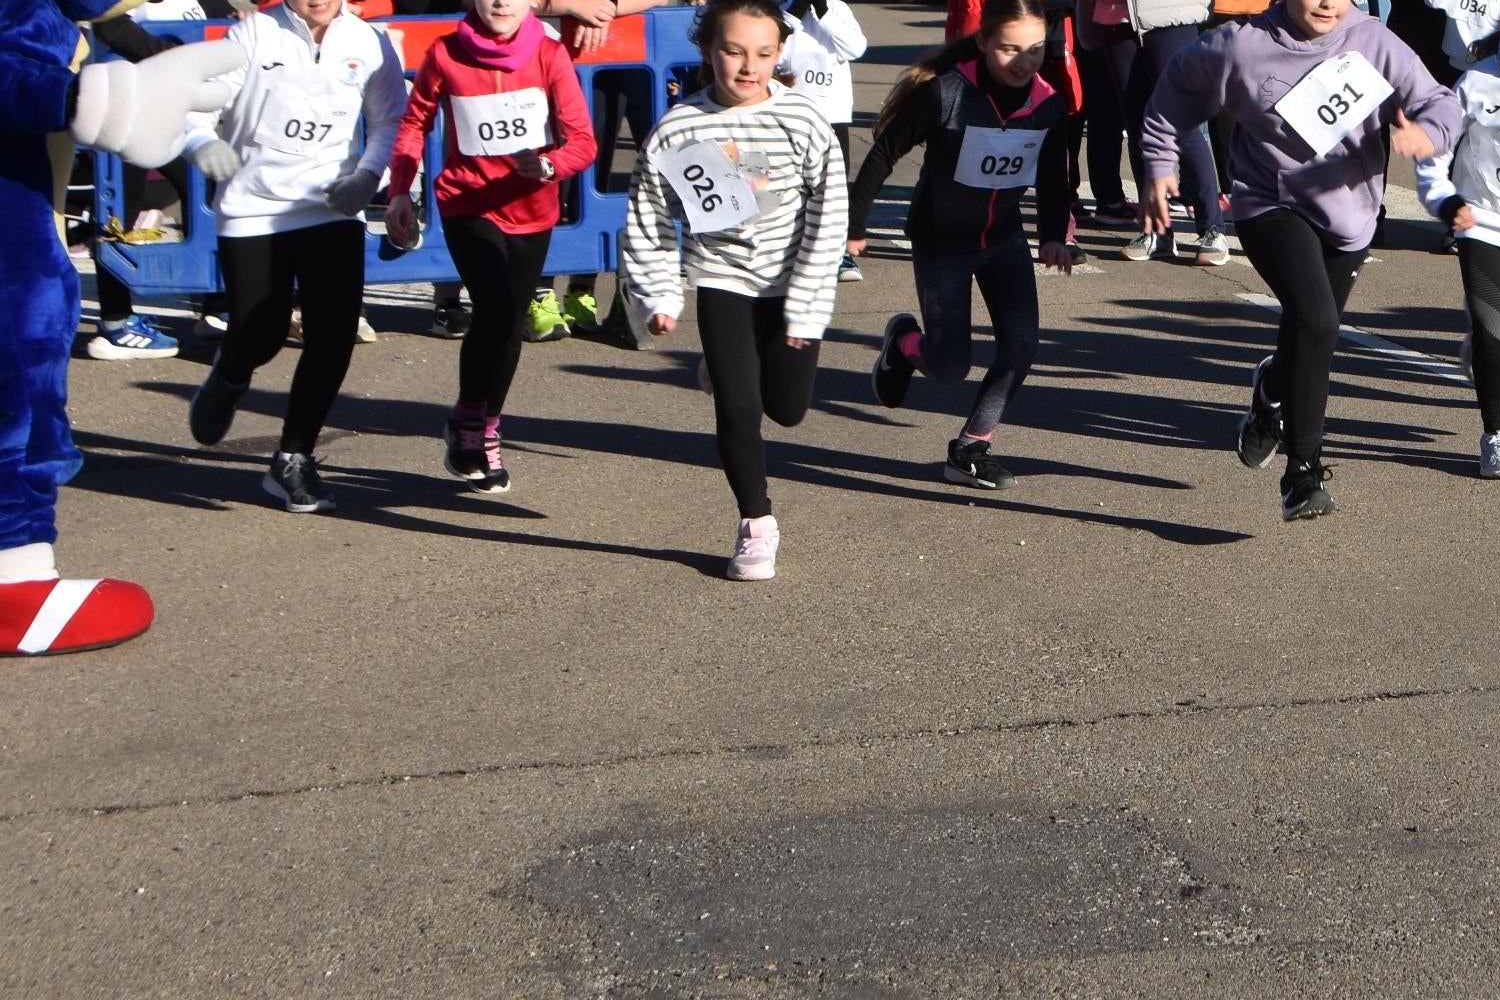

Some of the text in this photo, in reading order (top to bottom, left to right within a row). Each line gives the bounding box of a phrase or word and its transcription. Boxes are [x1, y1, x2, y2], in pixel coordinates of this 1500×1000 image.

[805, 69, 833, 87] 003
[1317, 82, 1364, 125] 031
[284, 119, 333, 142] 037
[478, 118, 527, 141] 038
[981, 155, 1024, 176] 029
[683, 164, 723, 212] 026
